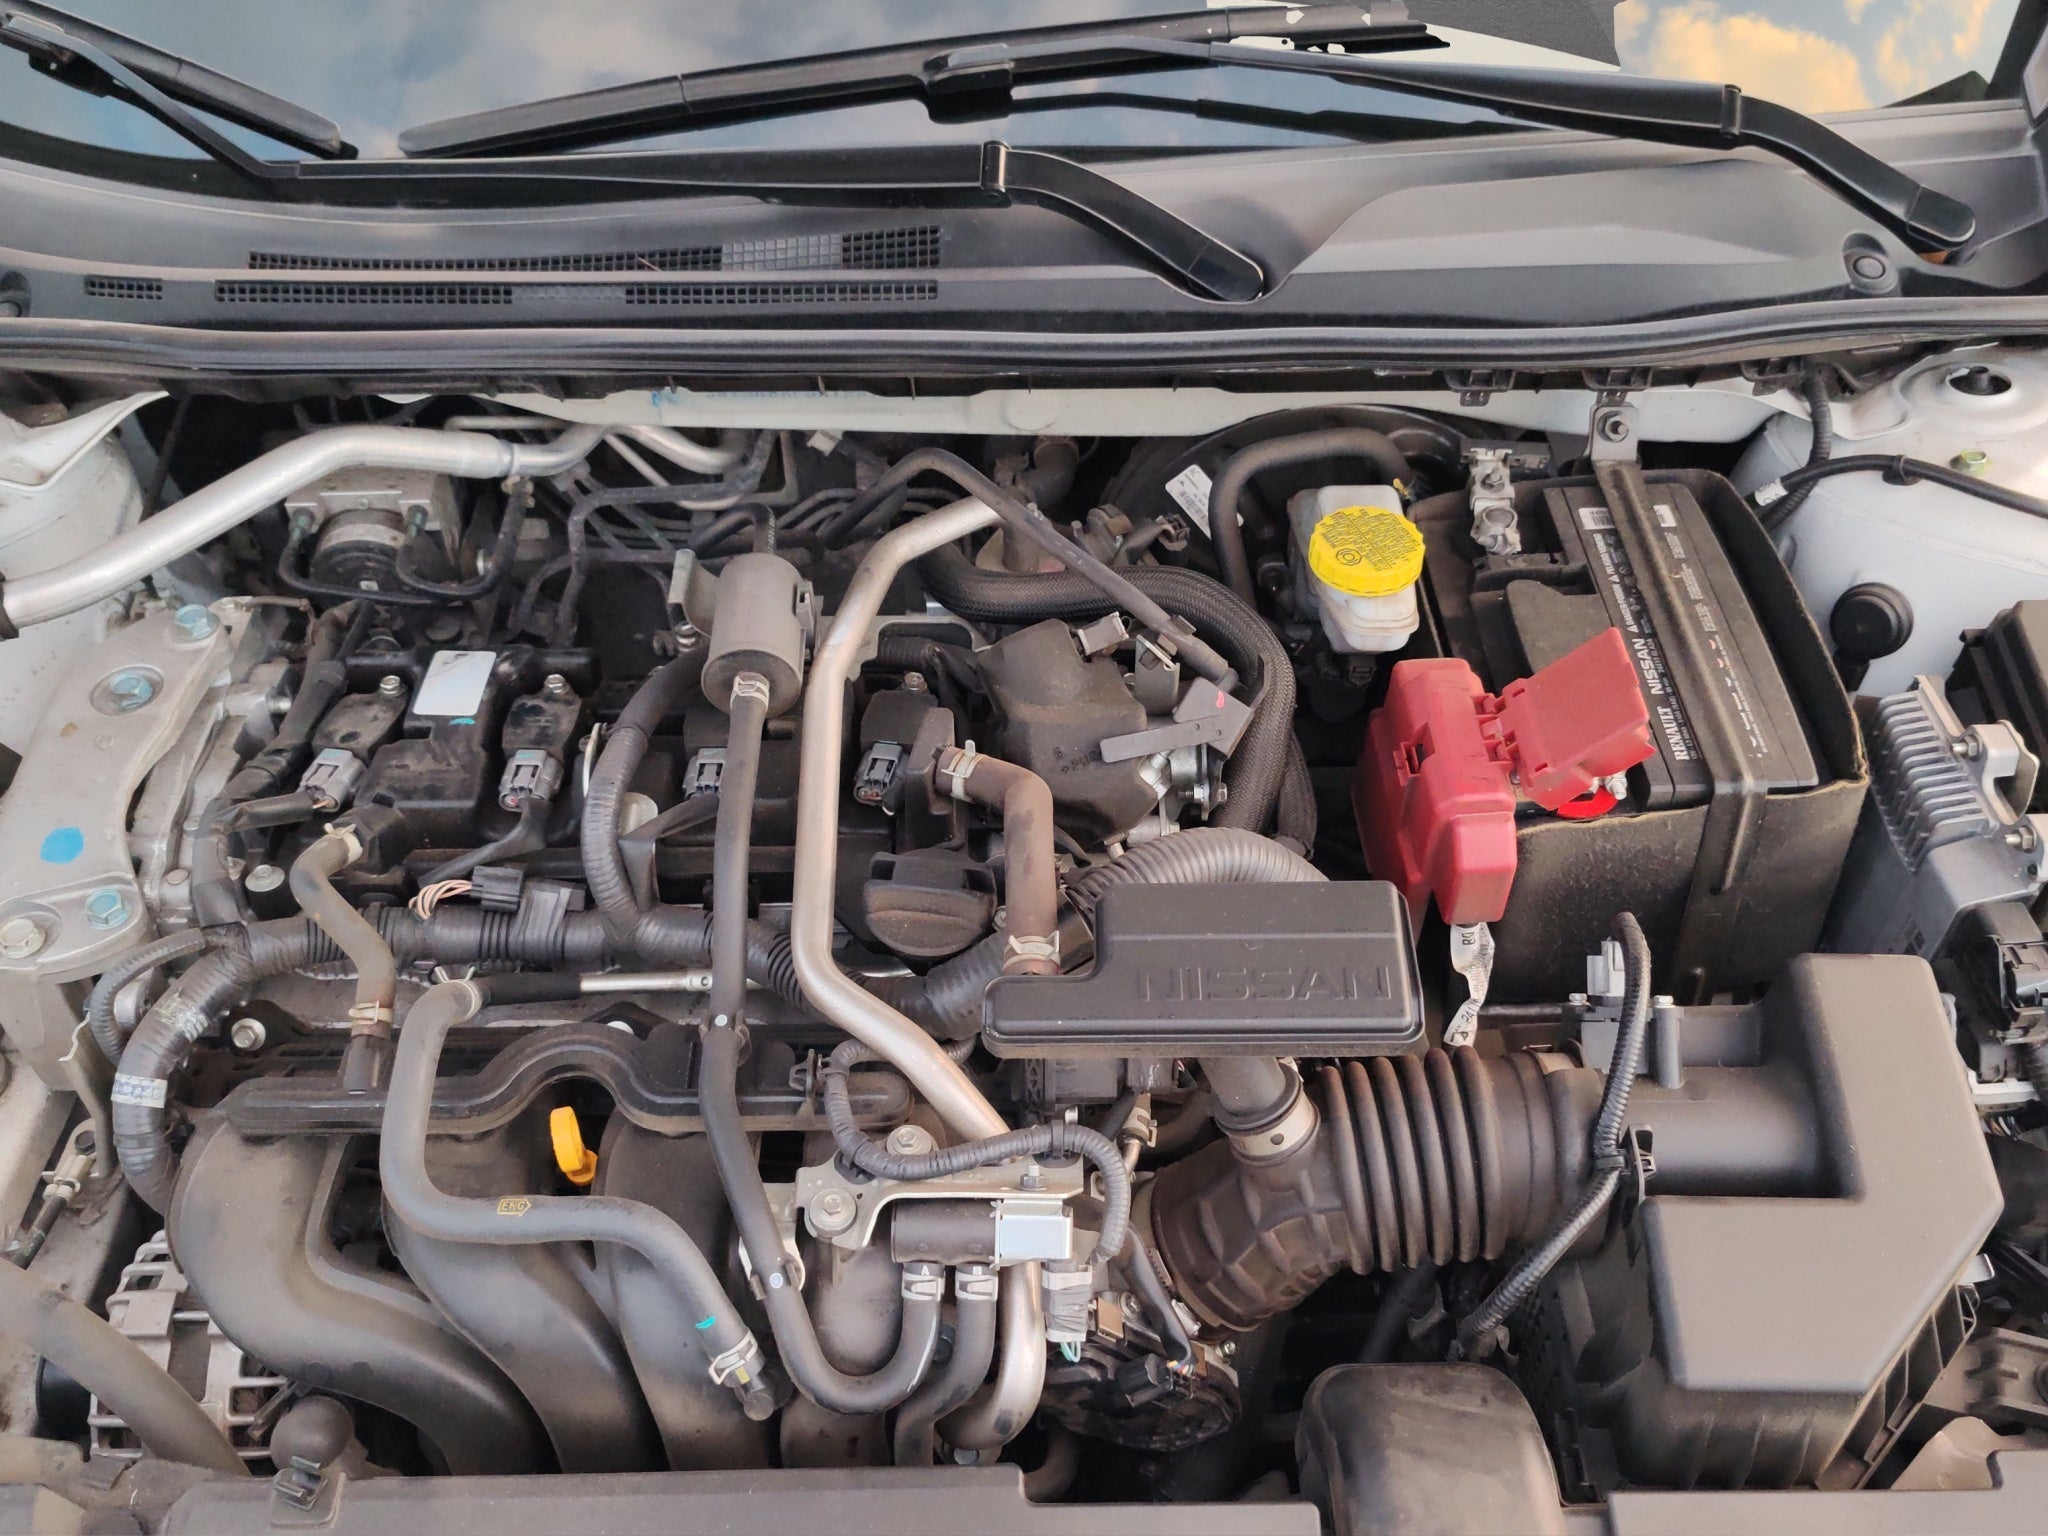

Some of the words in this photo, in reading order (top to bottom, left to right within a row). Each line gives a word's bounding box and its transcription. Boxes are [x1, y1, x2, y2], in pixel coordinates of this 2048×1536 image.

[1632, 638, 1664, 695] NISSAN
[1656, 706, 1690, 760] RENAULT
[1136, 966, 1391, 1001] NISSAN
[501, 1201, 526, 1211] ENG
[921, 1264, 930, 1276] A
